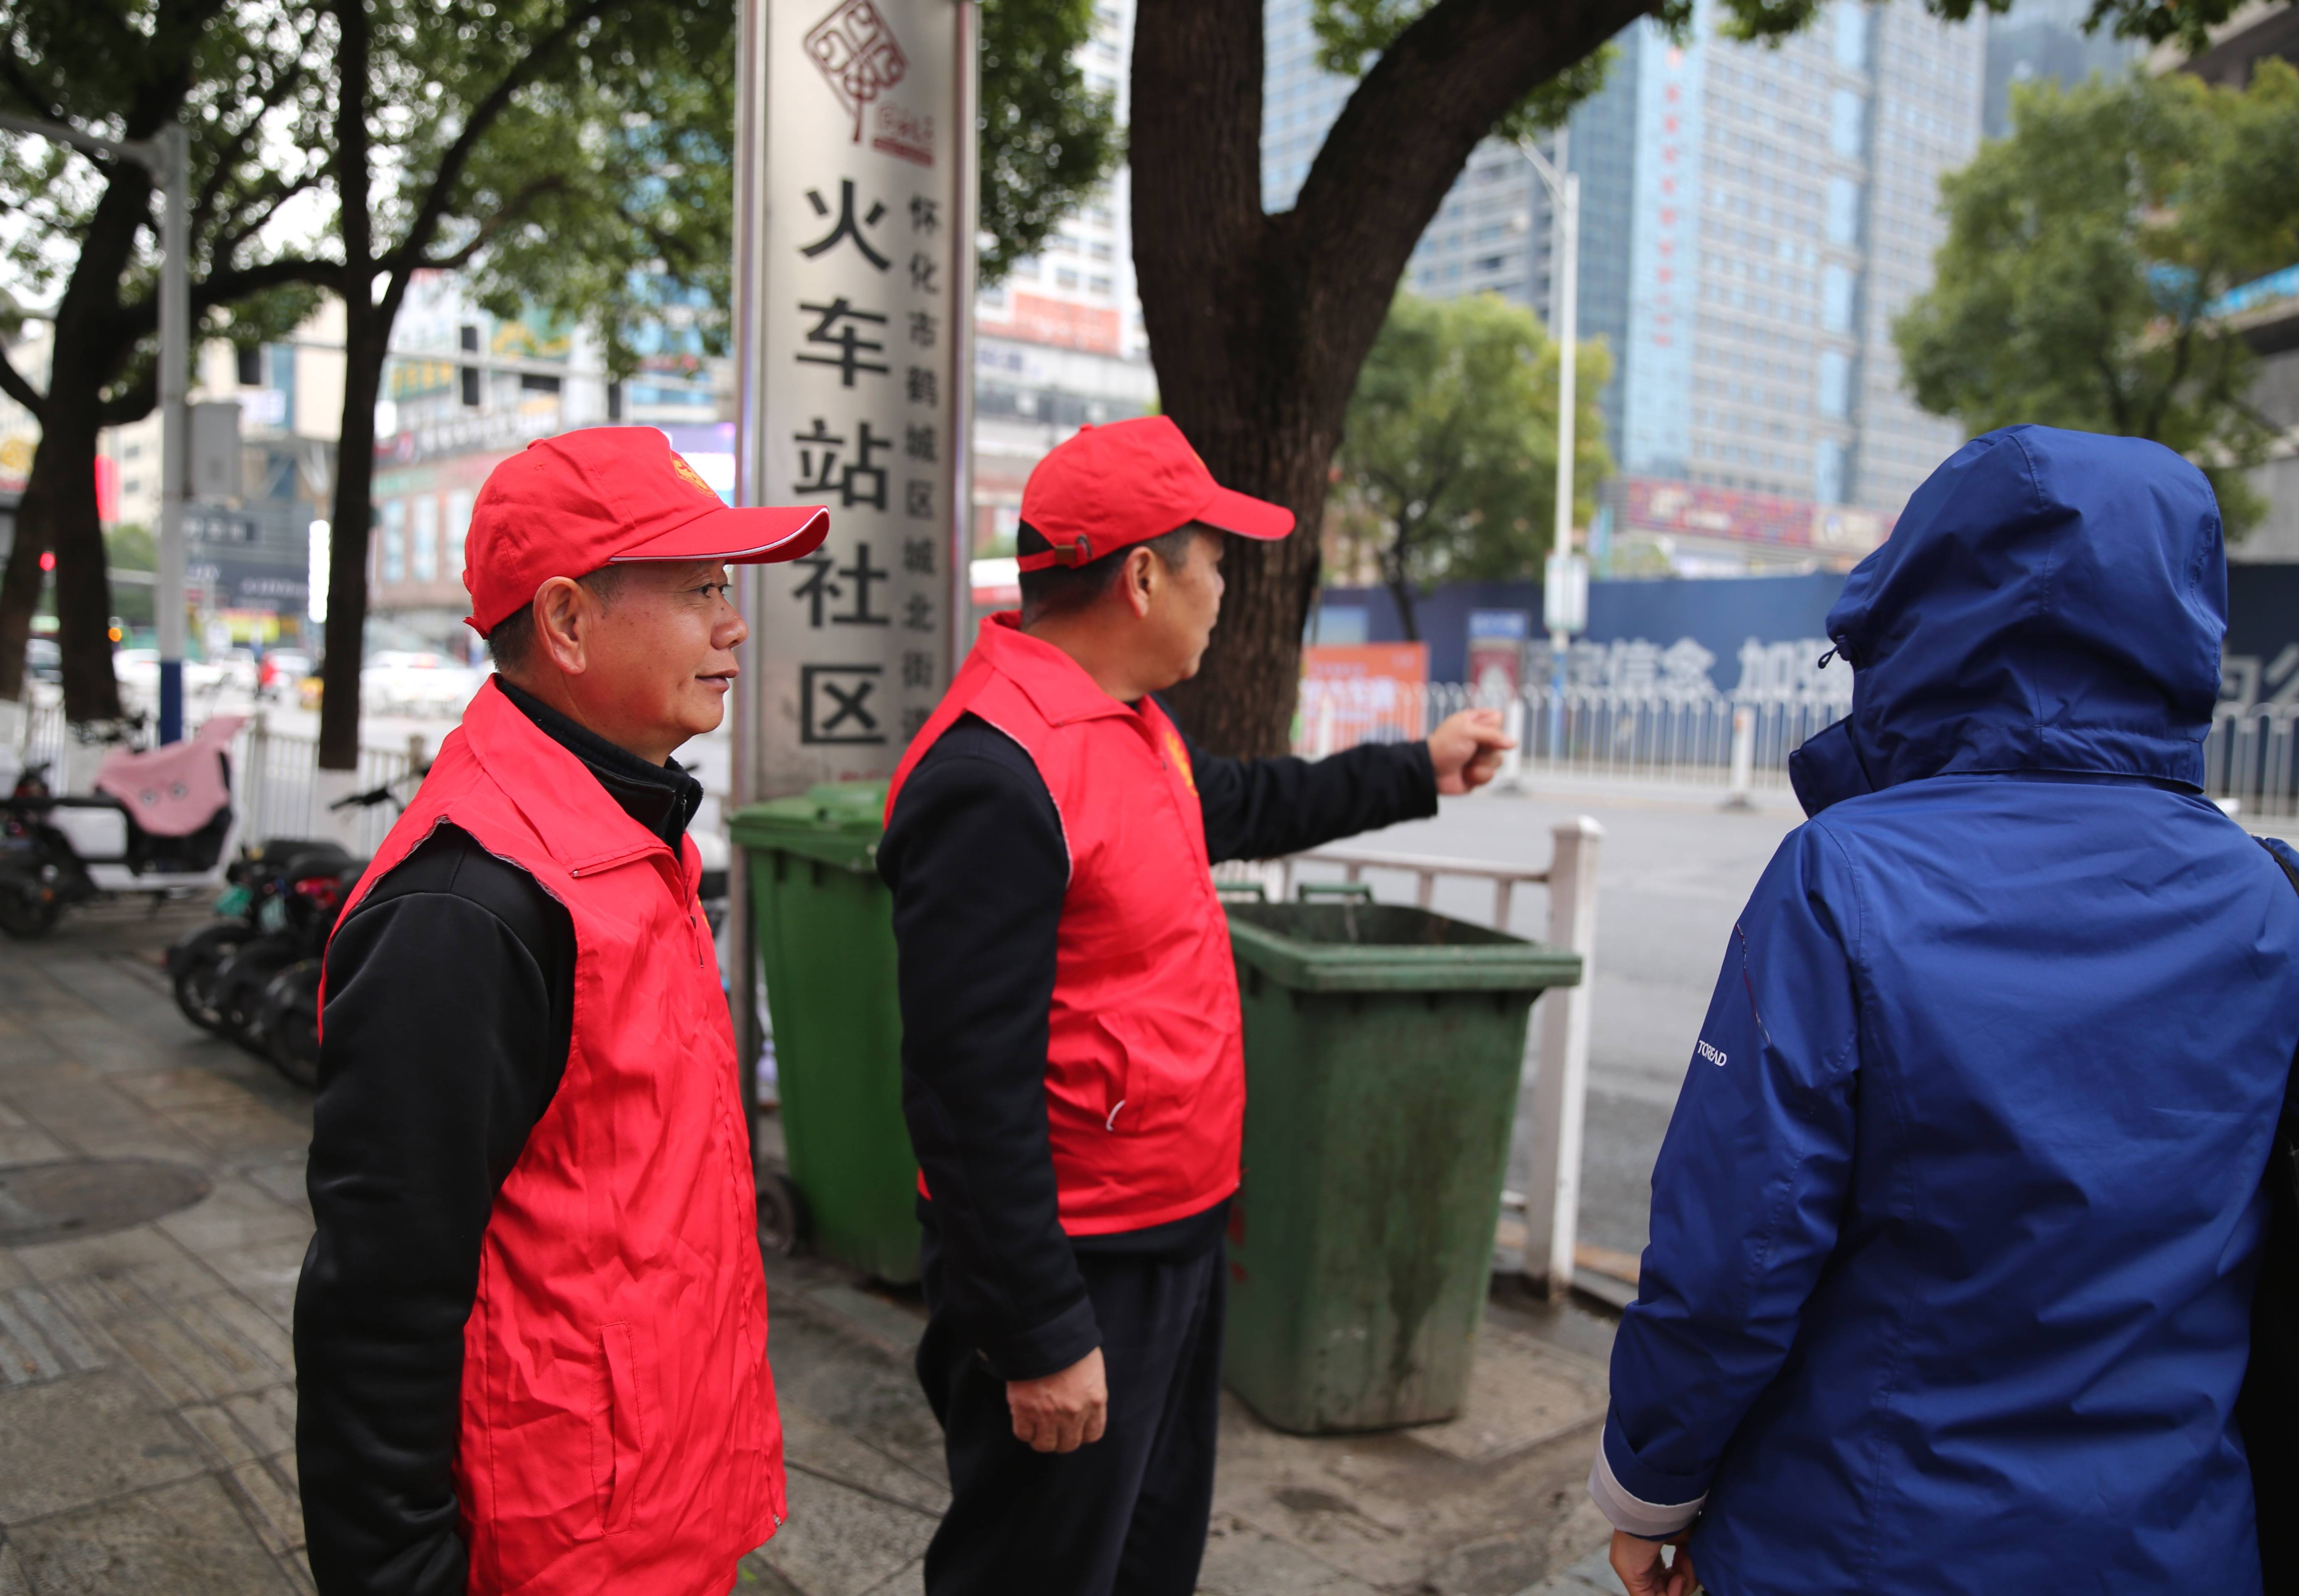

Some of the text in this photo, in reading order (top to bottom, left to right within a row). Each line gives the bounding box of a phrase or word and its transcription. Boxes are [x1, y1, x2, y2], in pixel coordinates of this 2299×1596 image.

[792, 179, 893, 745] 火车站社区
[1697, 1040, 1727, 1066] TOREAD
